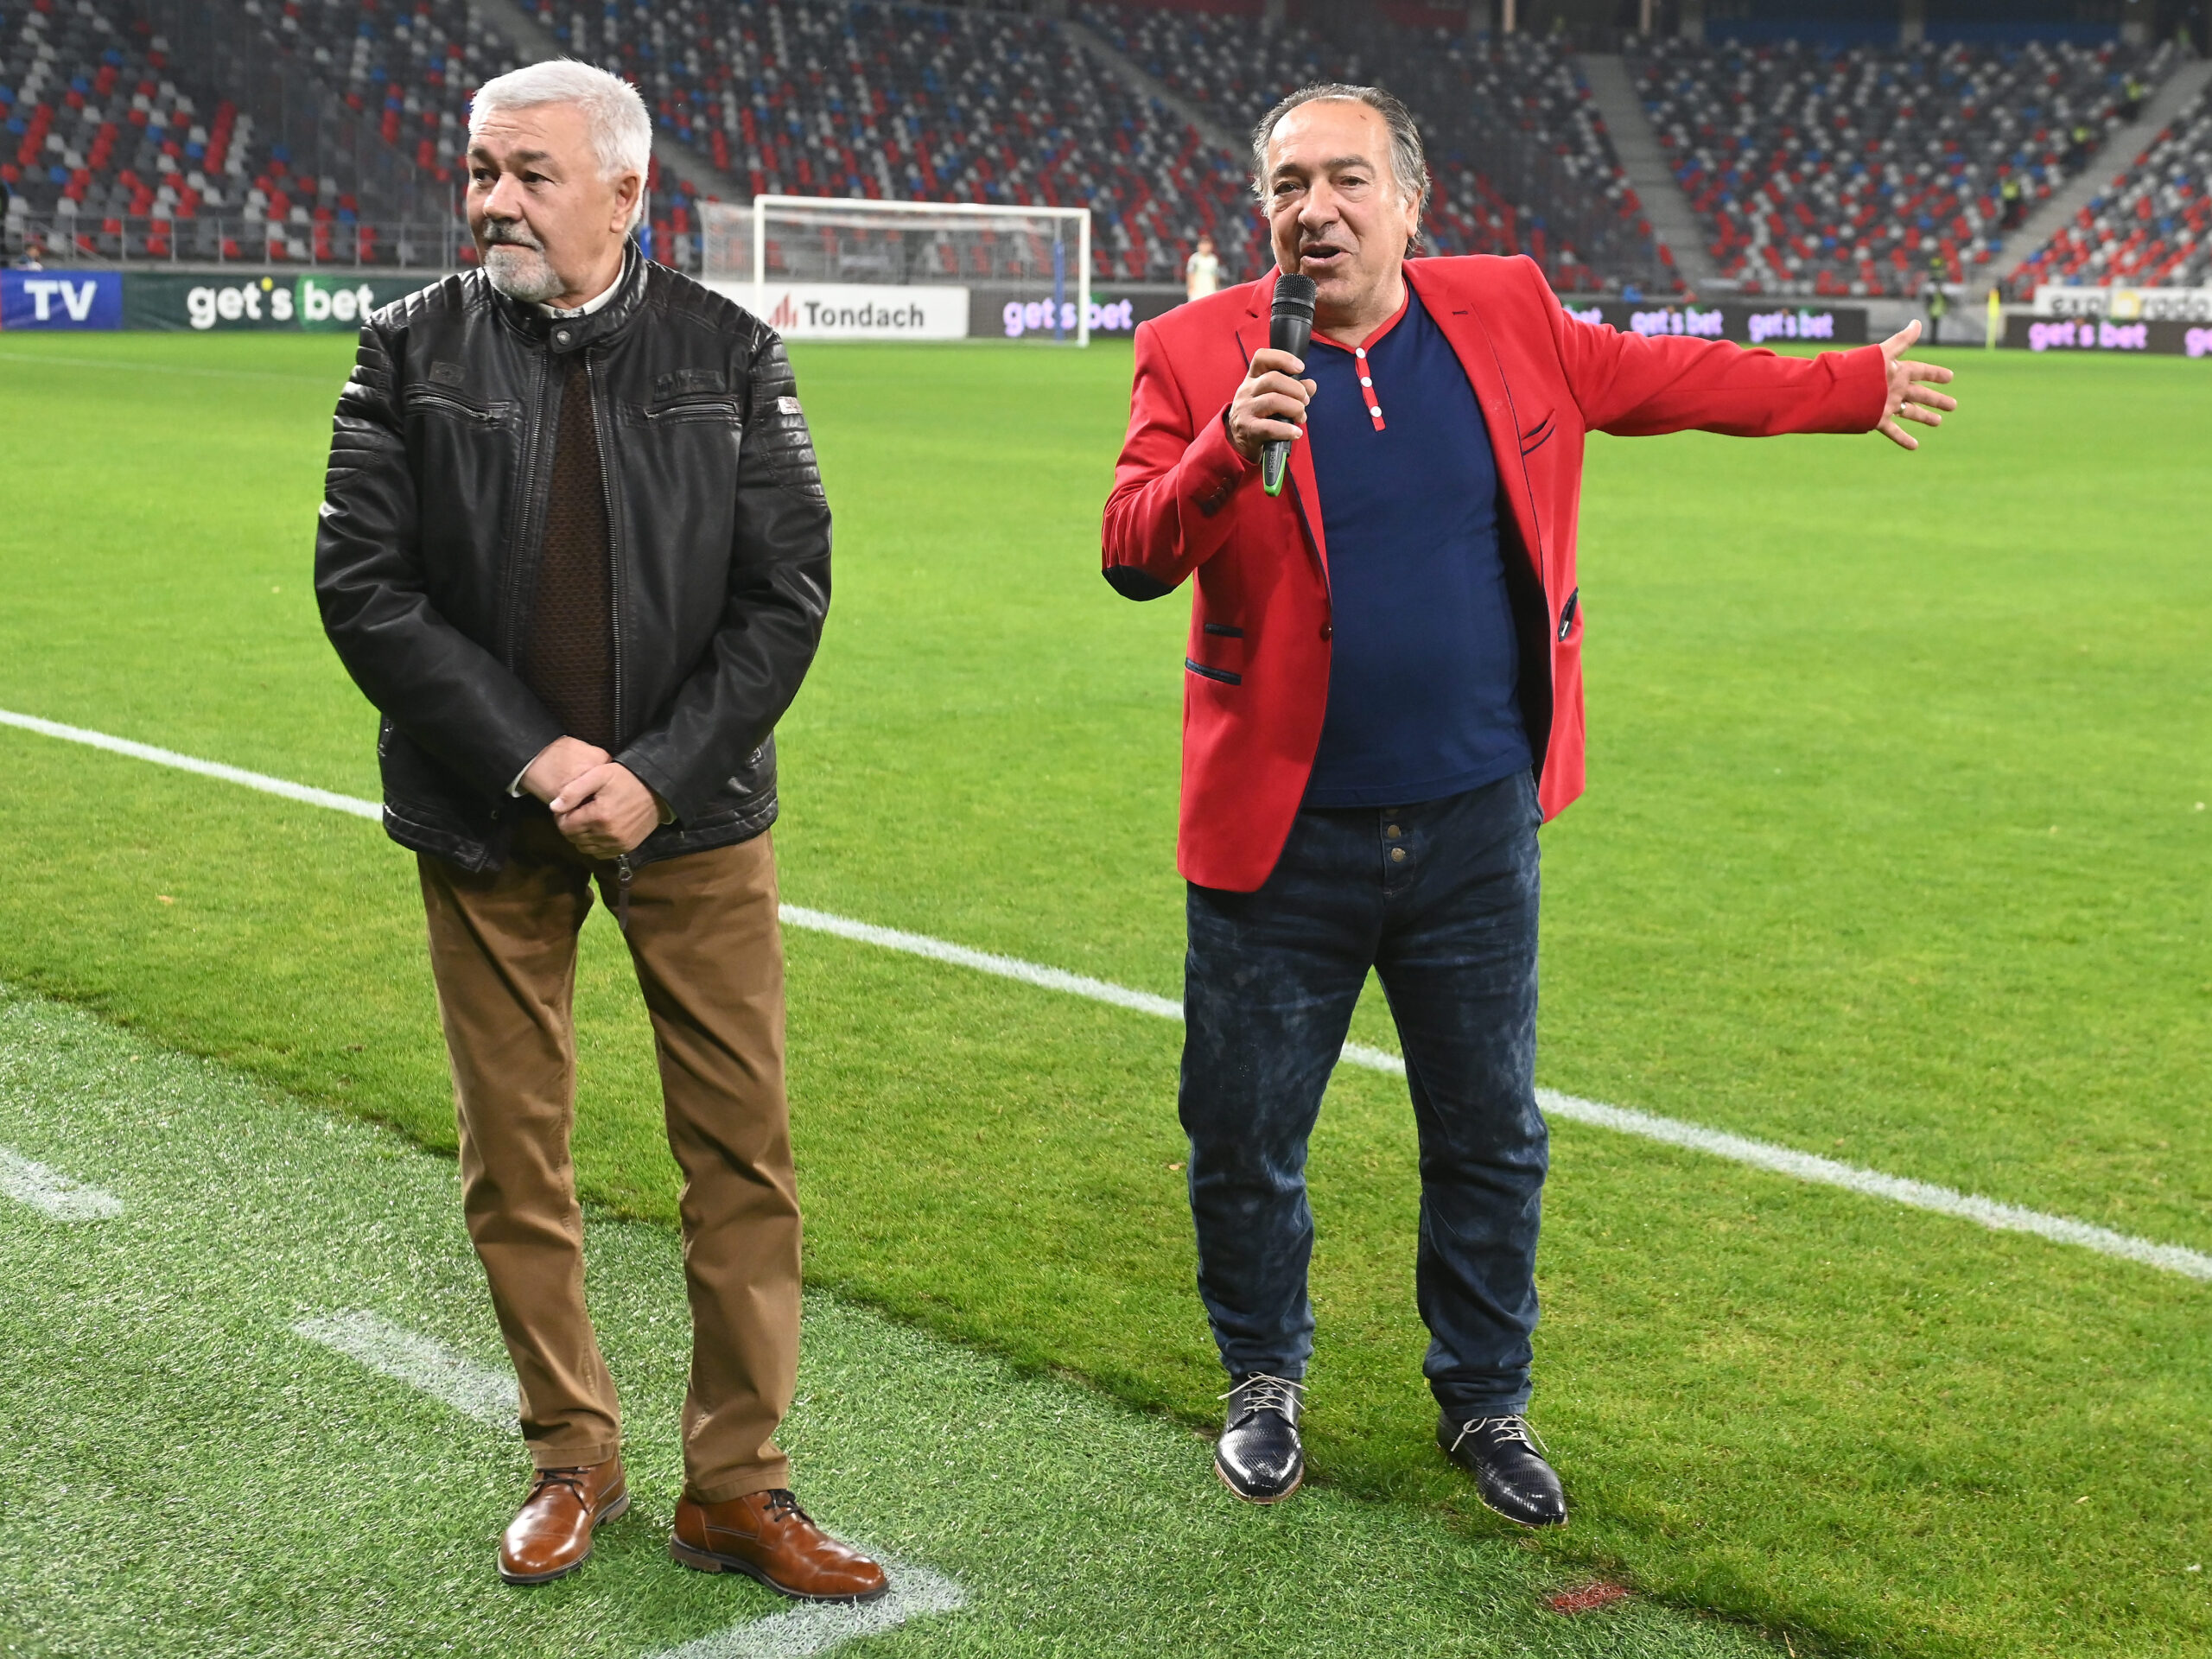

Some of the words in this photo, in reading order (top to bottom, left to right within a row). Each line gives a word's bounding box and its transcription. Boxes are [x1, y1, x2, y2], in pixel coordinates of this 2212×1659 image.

[23, 279, 97, 321] TV
[187, 276, 293, 330] get's
[304, 280, 374, 322] bet
[804, 301, 925, 327] Tondach
